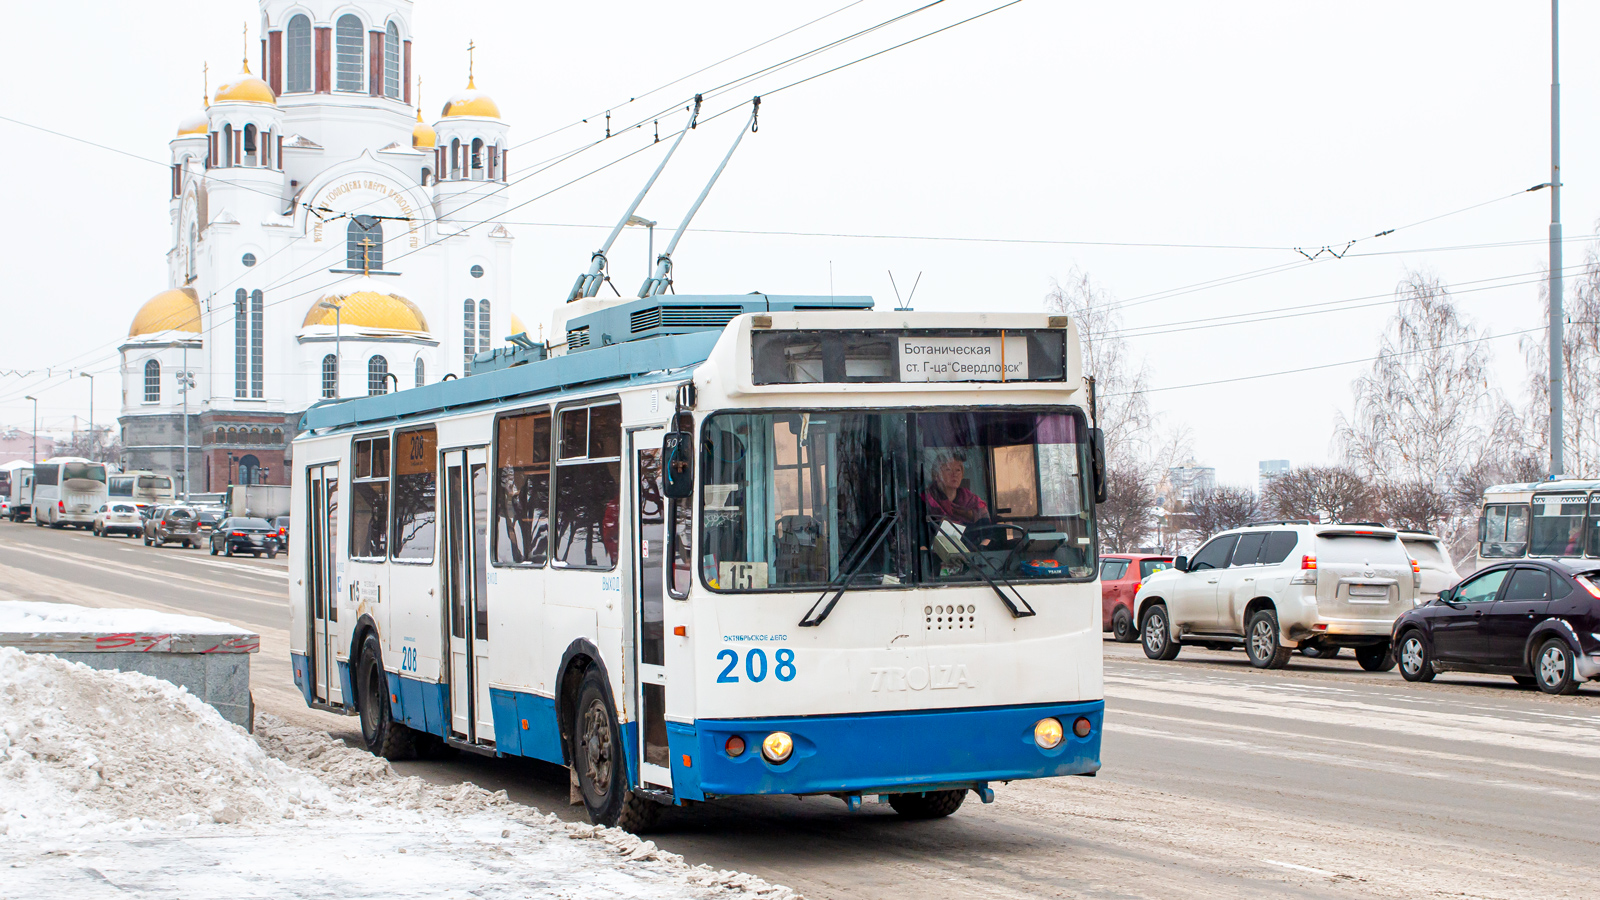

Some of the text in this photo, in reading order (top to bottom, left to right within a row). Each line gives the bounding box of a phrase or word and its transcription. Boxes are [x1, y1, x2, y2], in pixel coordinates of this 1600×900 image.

[904, 343, 991, 355] Ботаническая
[906, 364, 920, 373] ст.
[410, 435, 424, 460] 208
[602, 576, 620, 592] ВЫХОД
[729, 565, 753, 589] 15
[723, 634, 769, 642] ОКТЯБРЬСКОЕ
[402, 646, 418, 672] 208
[716, 648, 797, 684] 208
